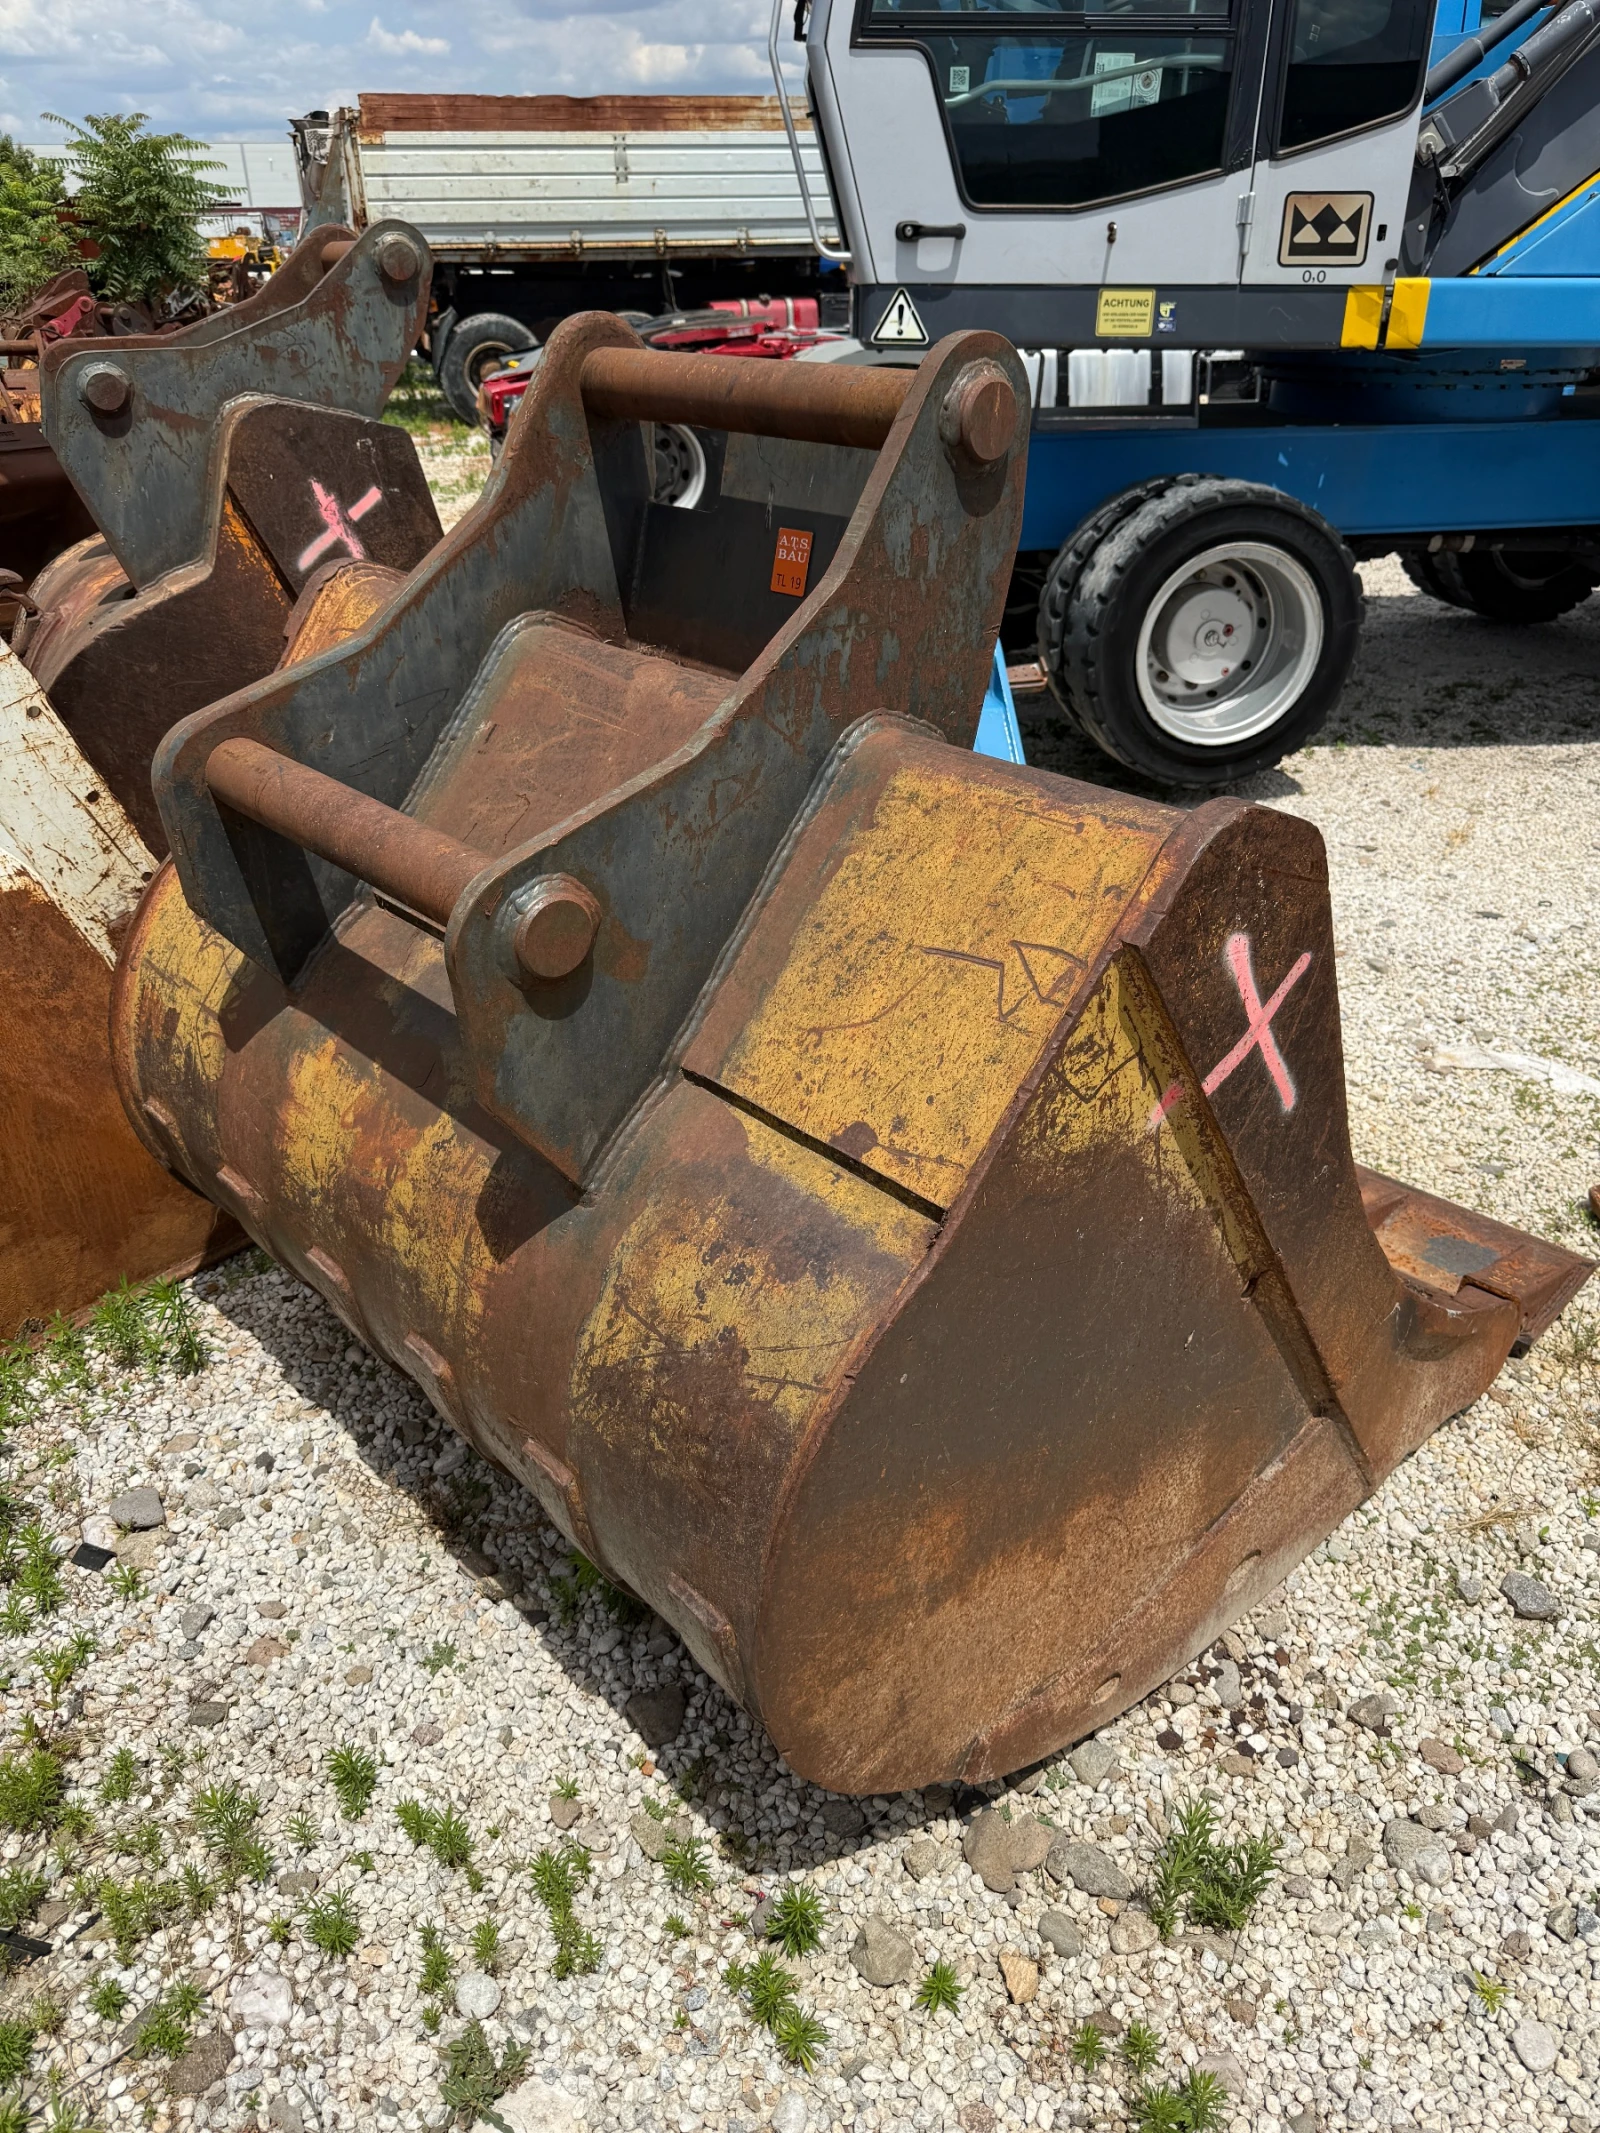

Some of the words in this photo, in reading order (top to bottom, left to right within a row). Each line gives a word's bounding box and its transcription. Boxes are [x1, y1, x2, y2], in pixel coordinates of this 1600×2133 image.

[1103, 299, 1149, 308] ACHTUNG
[778, 549, 807, 563] BAU
[776, 573, 786, 587] TL
[790, 576, 801, 589] 19
